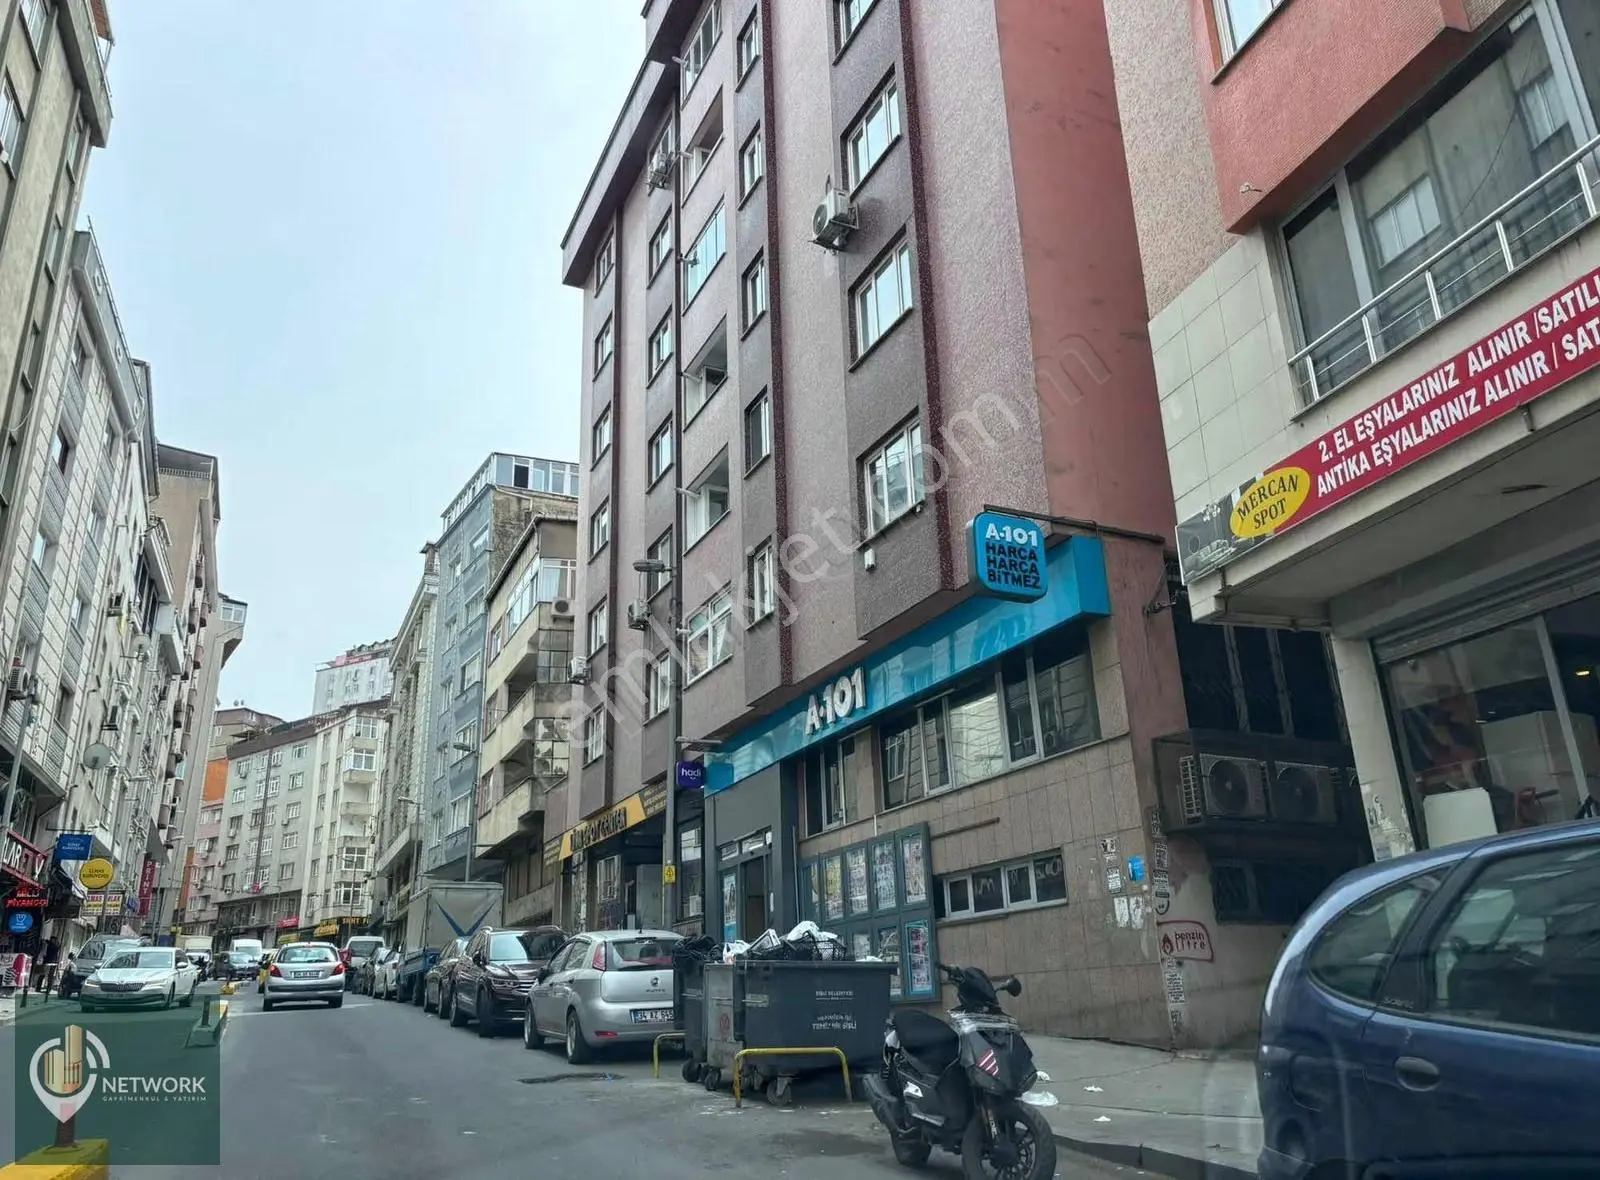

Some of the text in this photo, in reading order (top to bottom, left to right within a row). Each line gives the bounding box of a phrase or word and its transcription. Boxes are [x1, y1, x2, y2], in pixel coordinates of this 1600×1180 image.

[1317, 439, 1334, 464] 2.
[1333, 429, 1354, 455] EL
[1353, 361, 1460, 442] EŞYALARINIZ
[1467, 319, 1533, 378] ALINIR
[1316, 454, 1372, 499] ANTİKA
[1371, 387, 1482, 467] EŞYALARINIZ
[1484, 349, 1551, 407] ALINIR
[1236, 473, 1299, 523] MERCAN
[1252, 499, 1288, 530] SPOT
[985, 542, 1037, 562] HARCA
[986, 557, 1039, 575] HARCA
